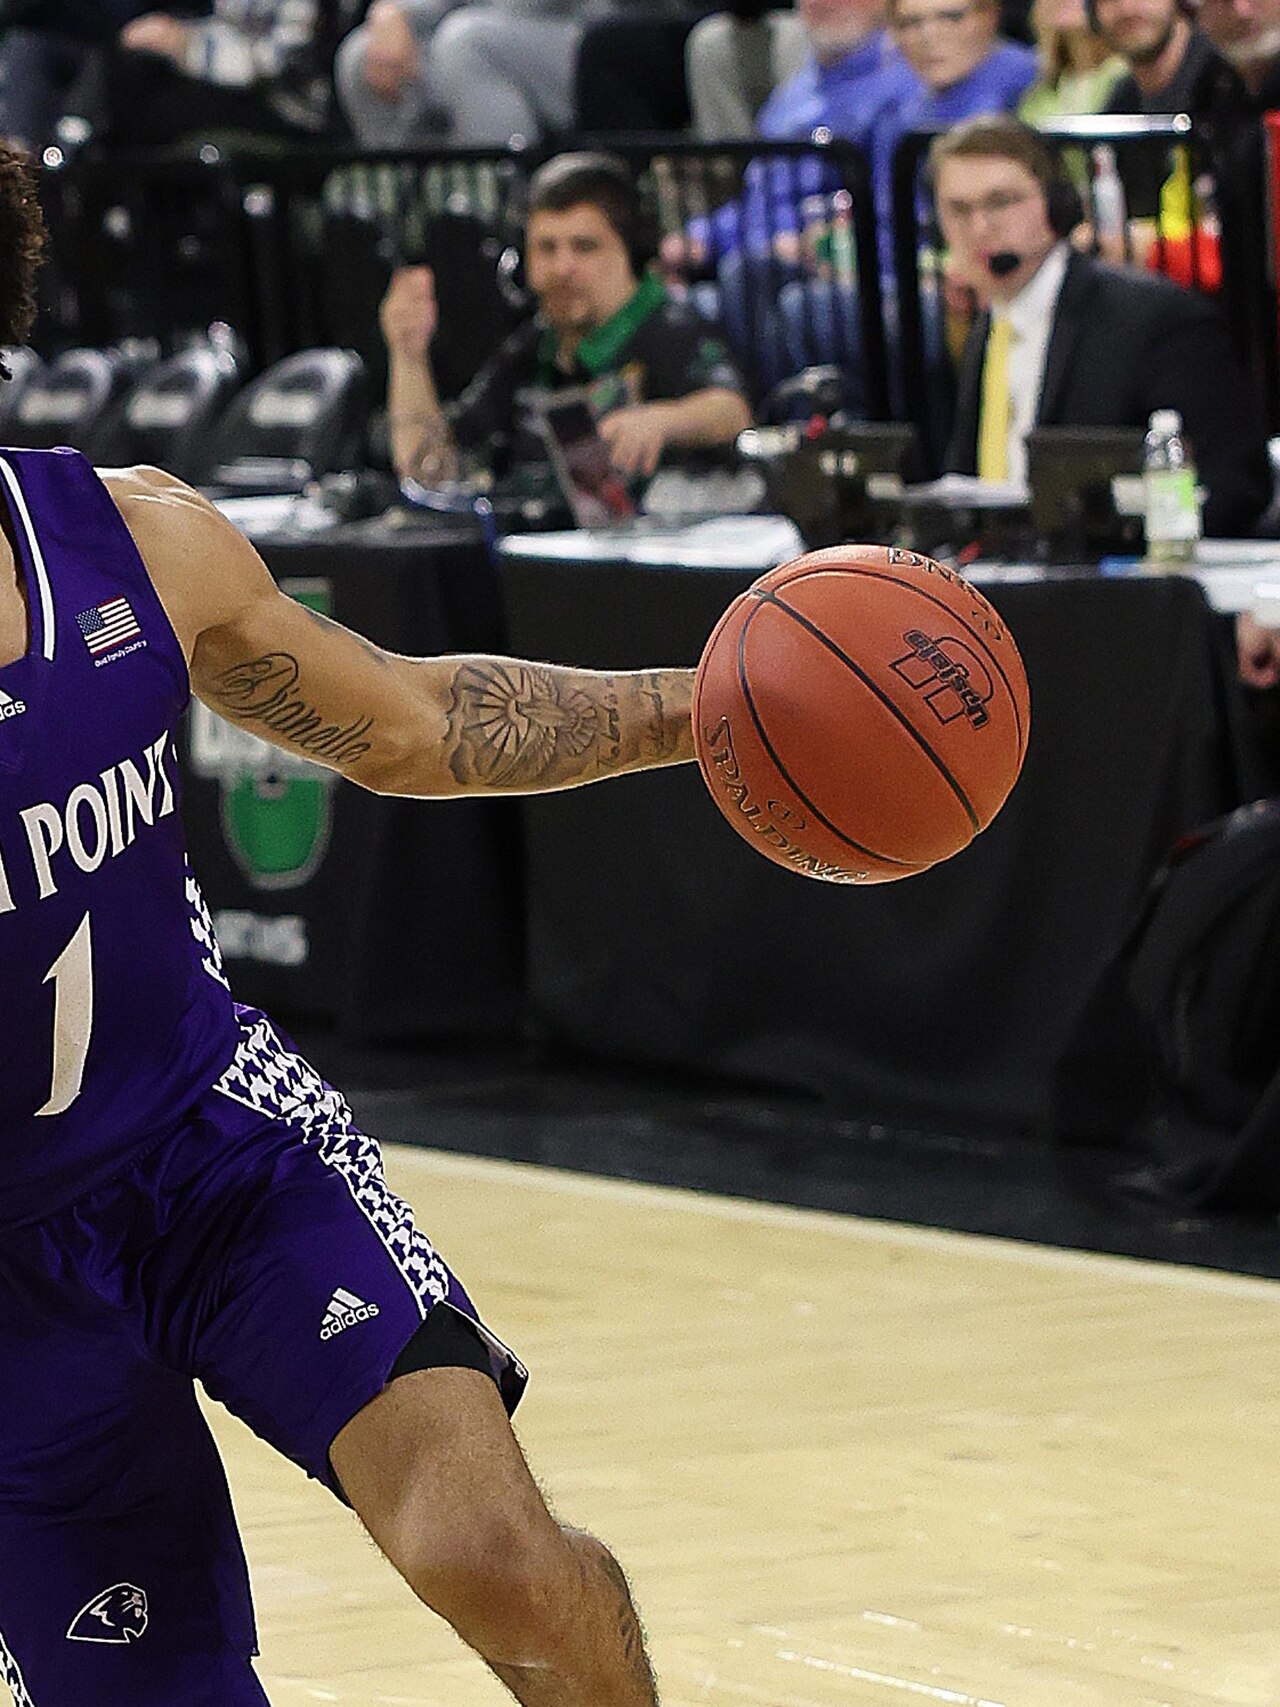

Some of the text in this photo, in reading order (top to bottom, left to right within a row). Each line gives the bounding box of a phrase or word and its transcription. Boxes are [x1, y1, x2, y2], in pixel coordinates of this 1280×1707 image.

[704, 715, 870, 883] SPALDING
[33, 910, 93, 1116] 1
[320, 1303, 380, 1340] adidas
